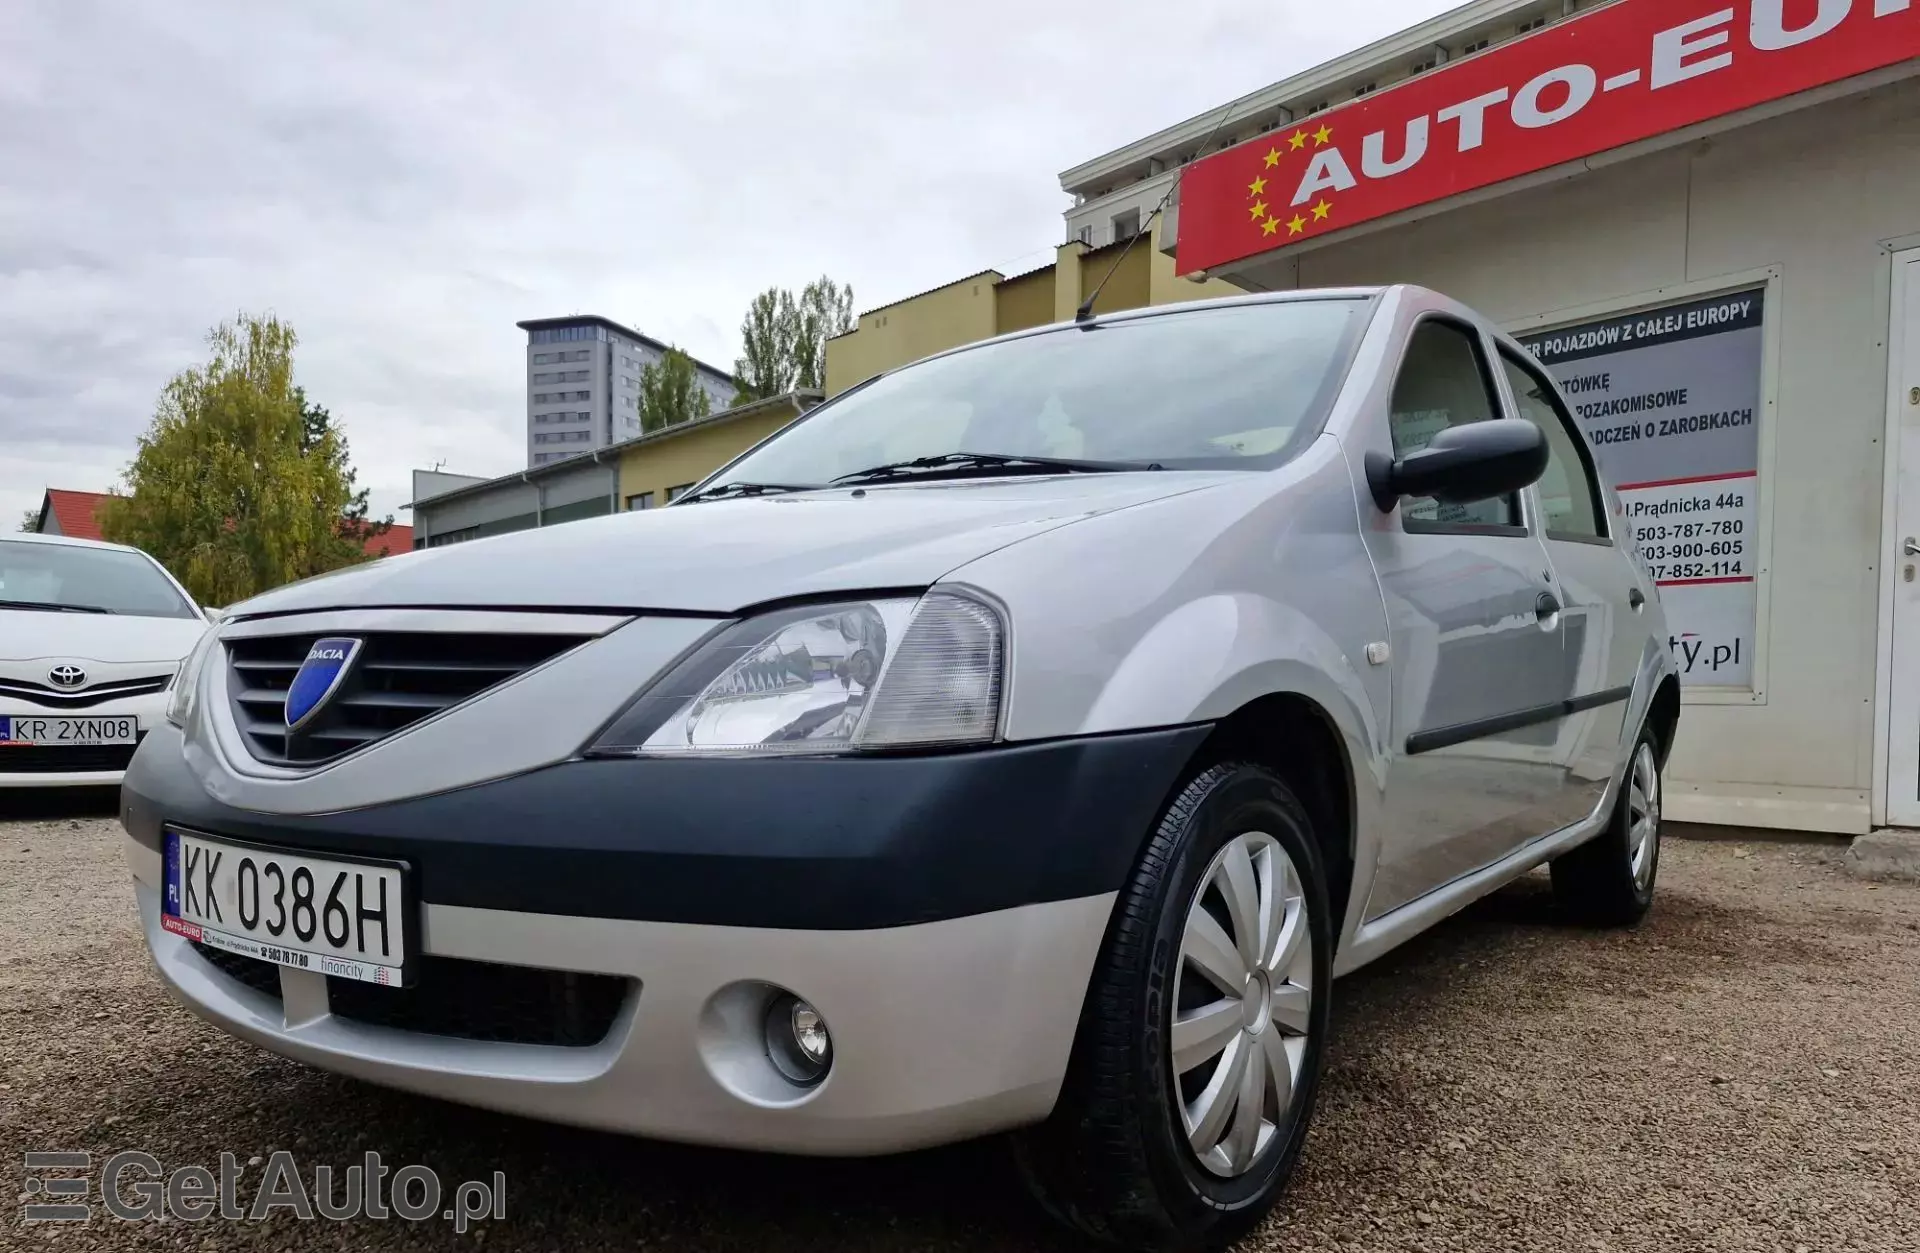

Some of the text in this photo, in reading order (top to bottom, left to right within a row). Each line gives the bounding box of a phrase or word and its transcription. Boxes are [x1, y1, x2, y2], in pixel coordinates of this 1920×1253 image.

[1290, 0, 1912, 207] AUTO-EU
[1544, 326, 1620, 356] POJAZDÓW
[1622, 324, 1632, 341] Z
[1636, 314, 1682, 338] CAŁEJ
[1687, 300, 1751, 329] EUROPY
[1559, 373, 1610, 394] TÓWKĘ
[1645, 422, 1655, 438] O
[1659, 408, 1752, 437] ZAROBKACH
[1715, 493, 1744, 509] 44a
[1636, 519, 1744, 542] 503-787-780
[309, 649, 344, 660] DACIA
[15, 720, 130, 739] KR 2XN08
[169, 883, 179, 903] PL
[184, 843, 390, 957] KK 0386H
[165, 919, 200, 938] AUTO-EURO
[320, 955, 364, 980] financity
